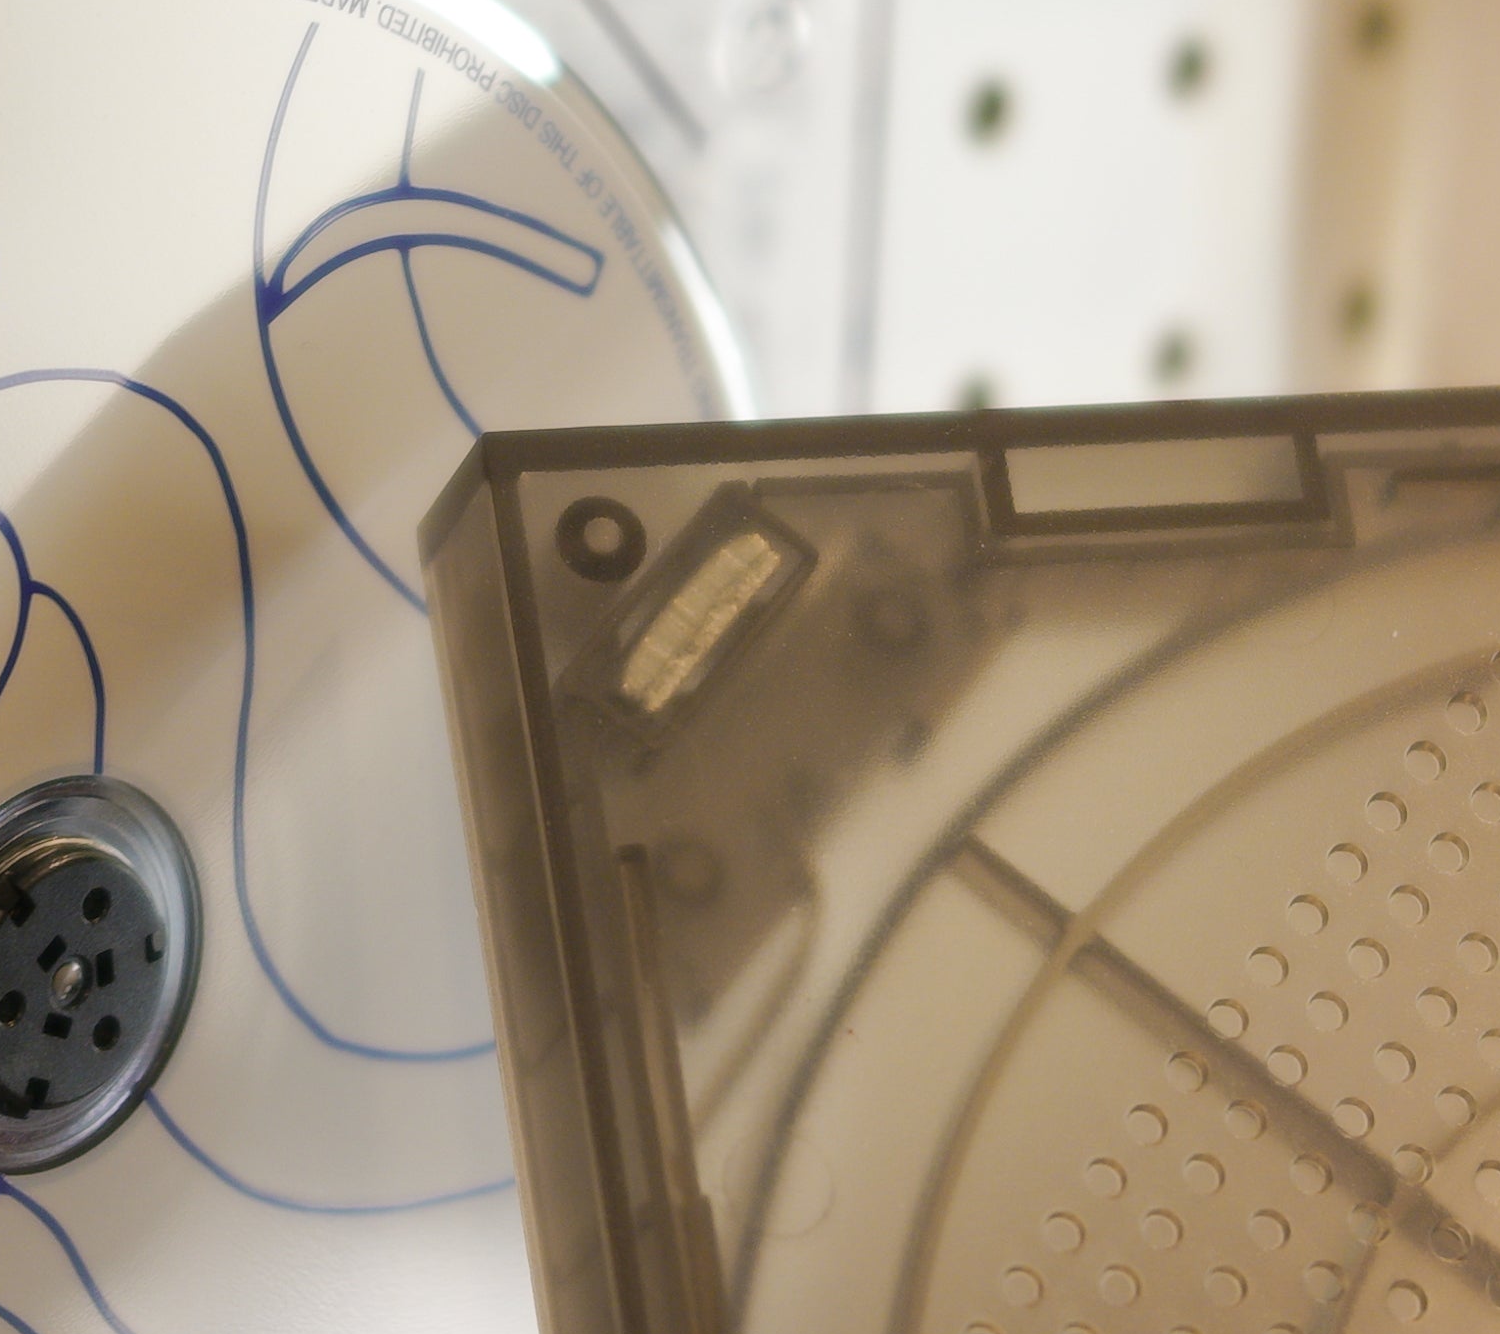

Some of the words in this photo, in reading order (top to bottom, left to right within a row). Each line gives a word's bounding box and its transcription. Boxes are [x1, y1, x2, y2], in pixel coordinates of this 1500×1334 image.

[376, 0, 497, 93] PROHIBITED.
[495, 80, 543, 130] DISC
[538, 120, 579, 171] THIS
[576, 168, 605, 199] OF
